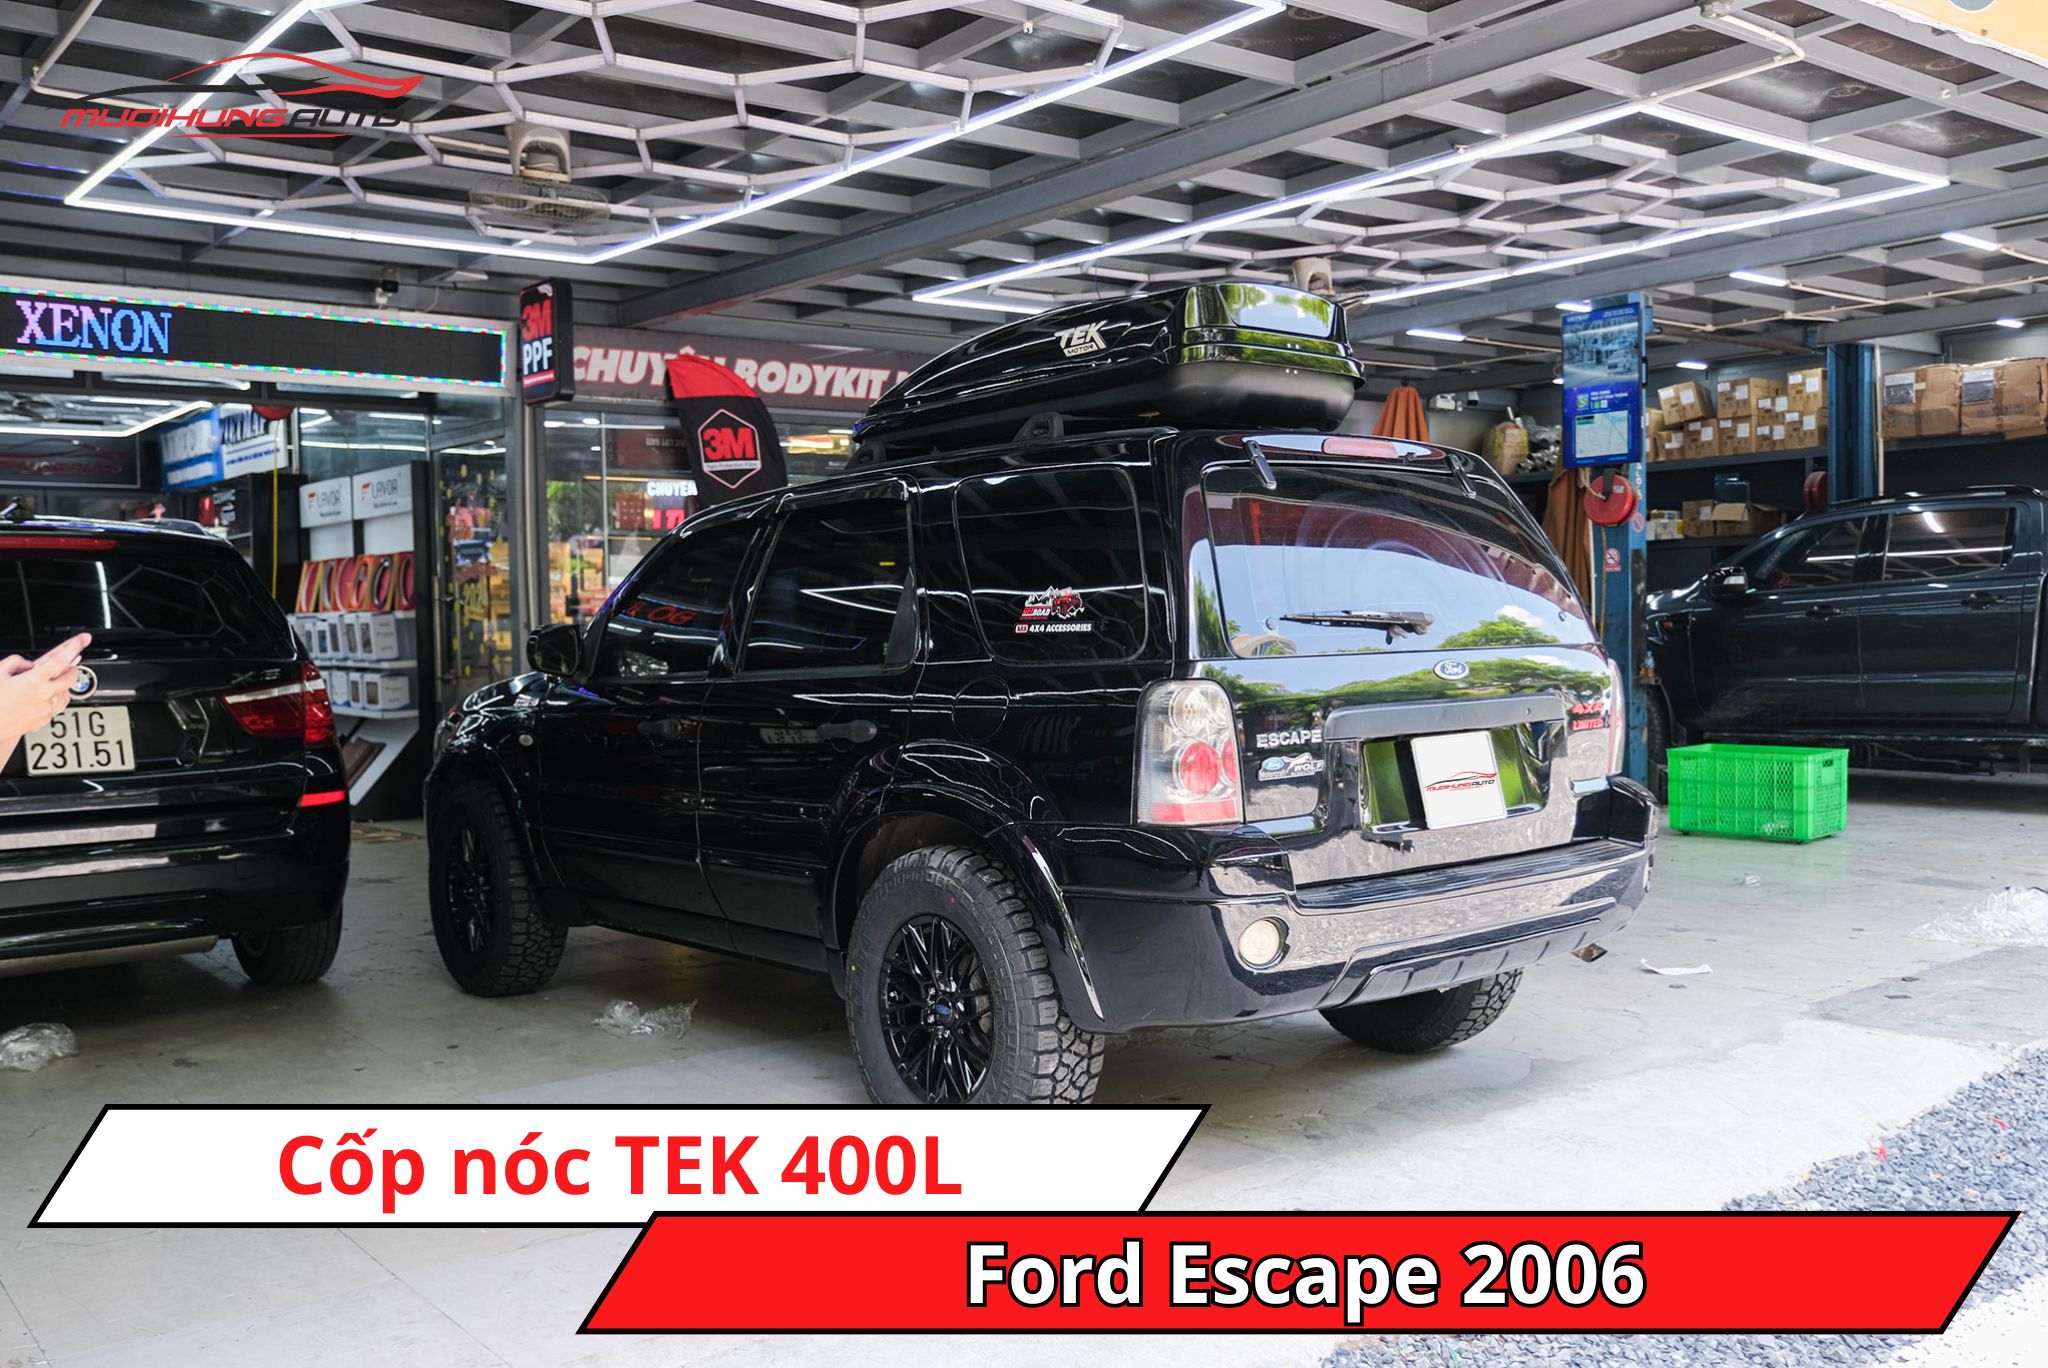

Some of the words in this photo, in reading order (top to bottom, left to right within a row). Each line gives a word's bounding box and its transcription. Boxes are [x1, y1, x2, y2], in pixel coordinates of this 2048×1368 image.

[16, 299, 172, 354] XENON
[522, 299, 552, 341] 3M
[1054, 320, 1109, 350] TEK
[523, 337, 553, 375] PPF
[1066, 344, 1095, 356] MOTOR
[573, 346, 726, 387] CHUY
[735, 358, 892, 400] BODYKIT
[703, 427, 756, 461] 3M
[1029, 624, 1046, 633] 4X4
[1046, 623, 1092, 633] ACCESSORIES
[51, 712, 106, 738] 51G
[1256, 729, 1322, 748] ESCAPE
[30, 740, 127, 770] 231.51
[1294, 762, 1324, 773] WOLF
